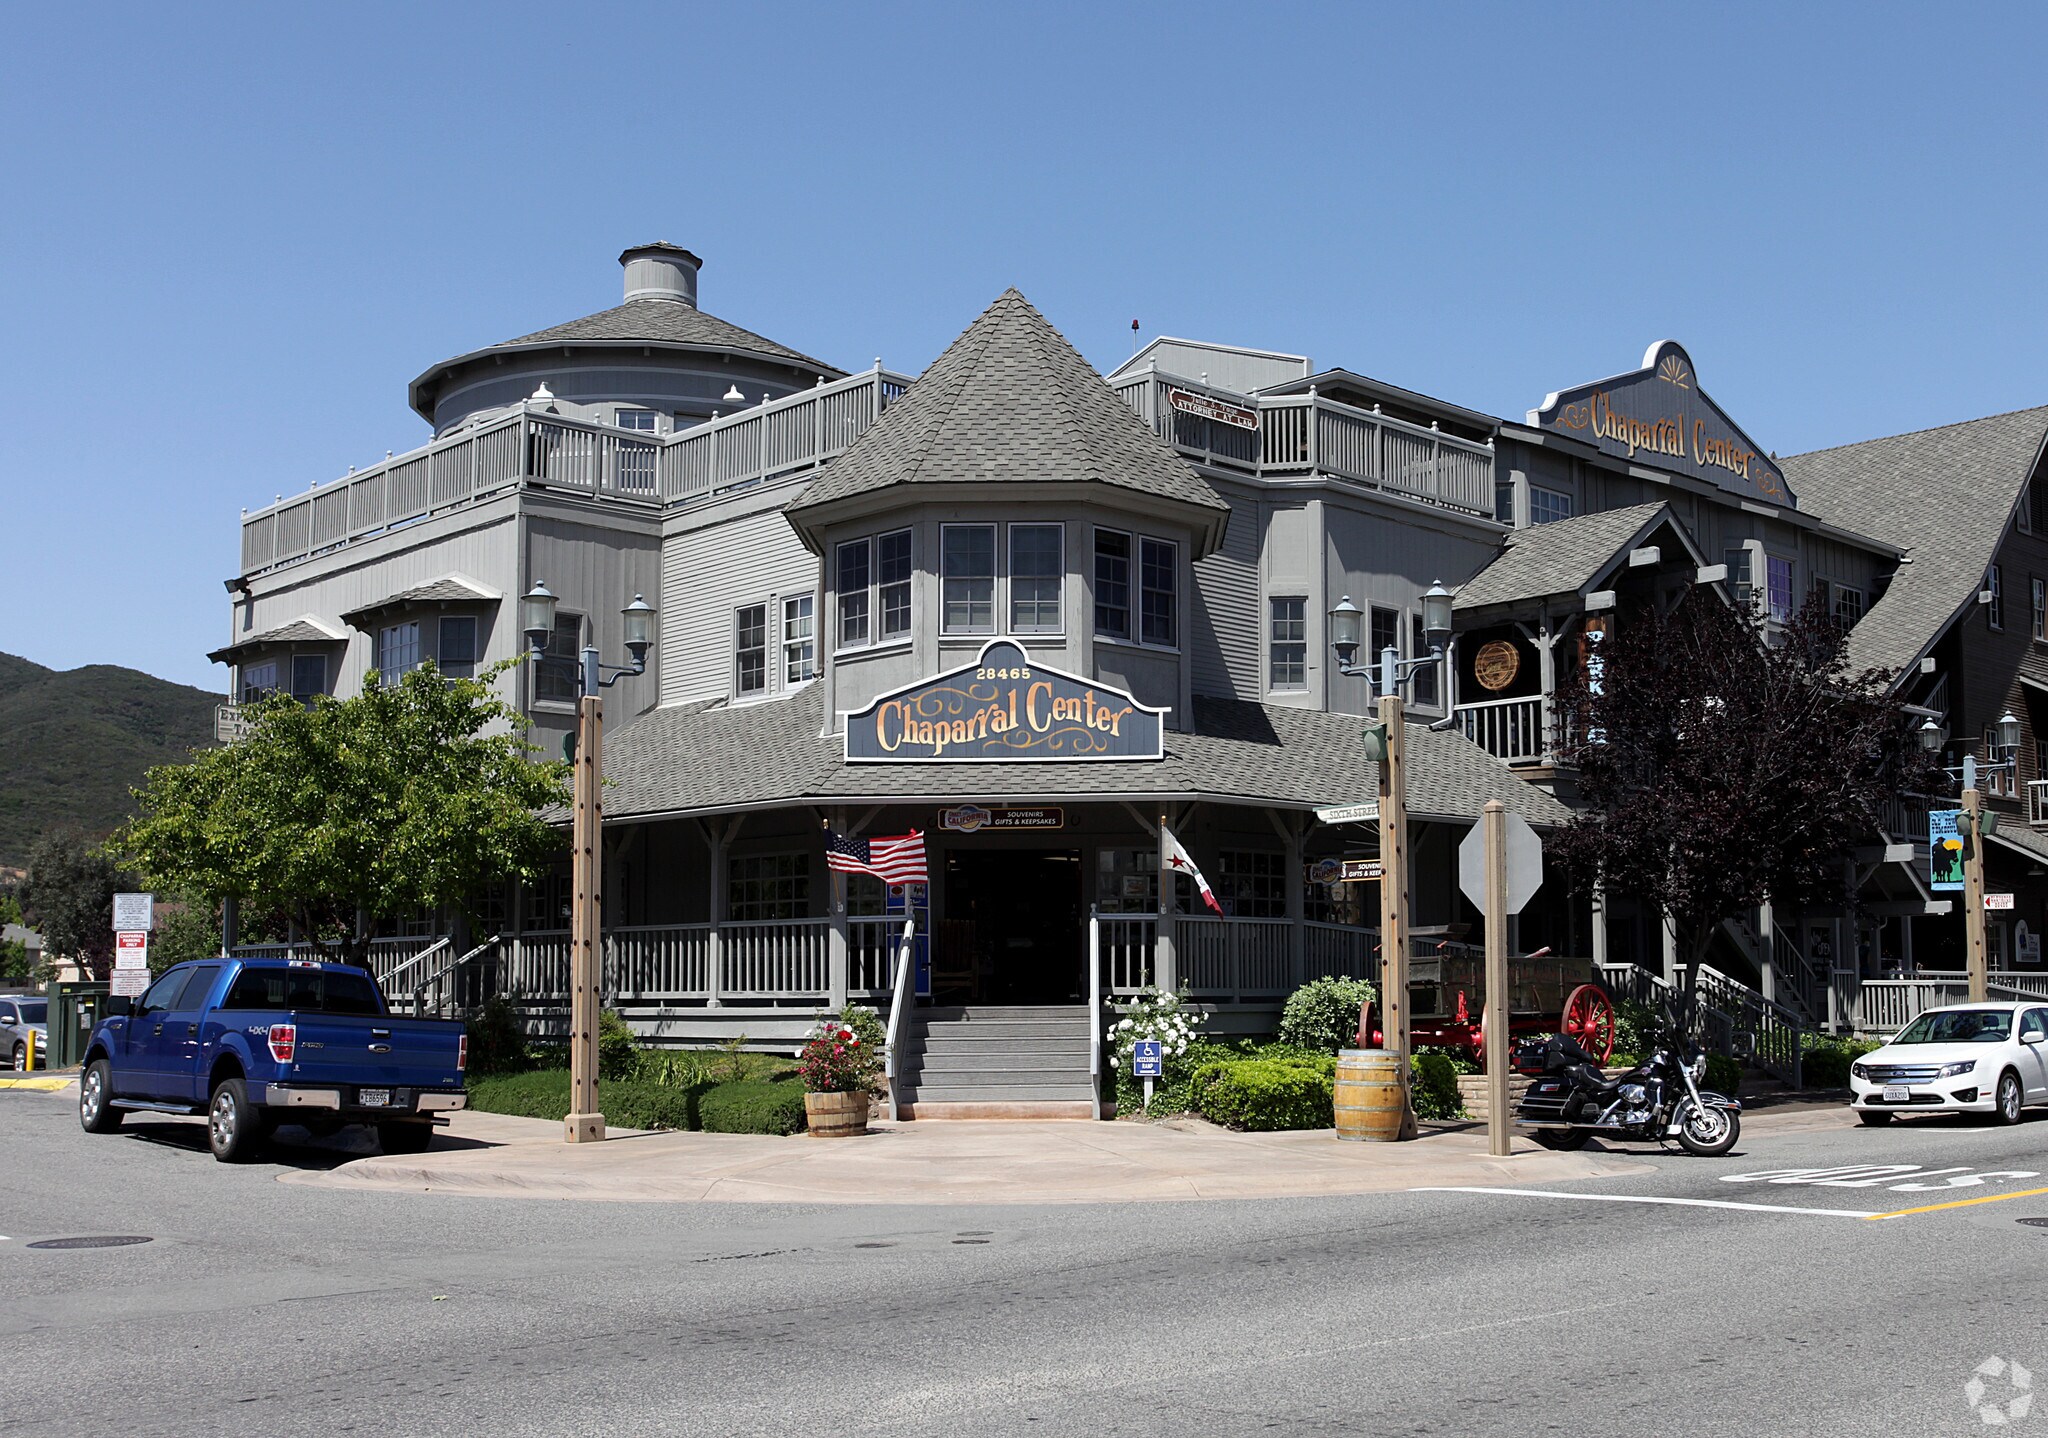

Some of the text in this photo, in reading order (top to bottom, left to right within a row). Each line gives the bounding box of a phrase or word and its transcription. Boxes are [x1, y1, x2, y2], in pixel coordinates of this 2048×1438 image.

[1178, 401, 1252, 428] ATTORNEY AT LAW
[1590, 388, 1755, 481] Chaparral Center
[976, 668, 1031, 680] 28465
[876, 681, 1133, 756] Chaparral Center
[947, 812, 988, 824] CALIFORNIA
[1329, 809, 1352, 820] SIXTH
[1718, 1164, 2039, 1191] STOP
